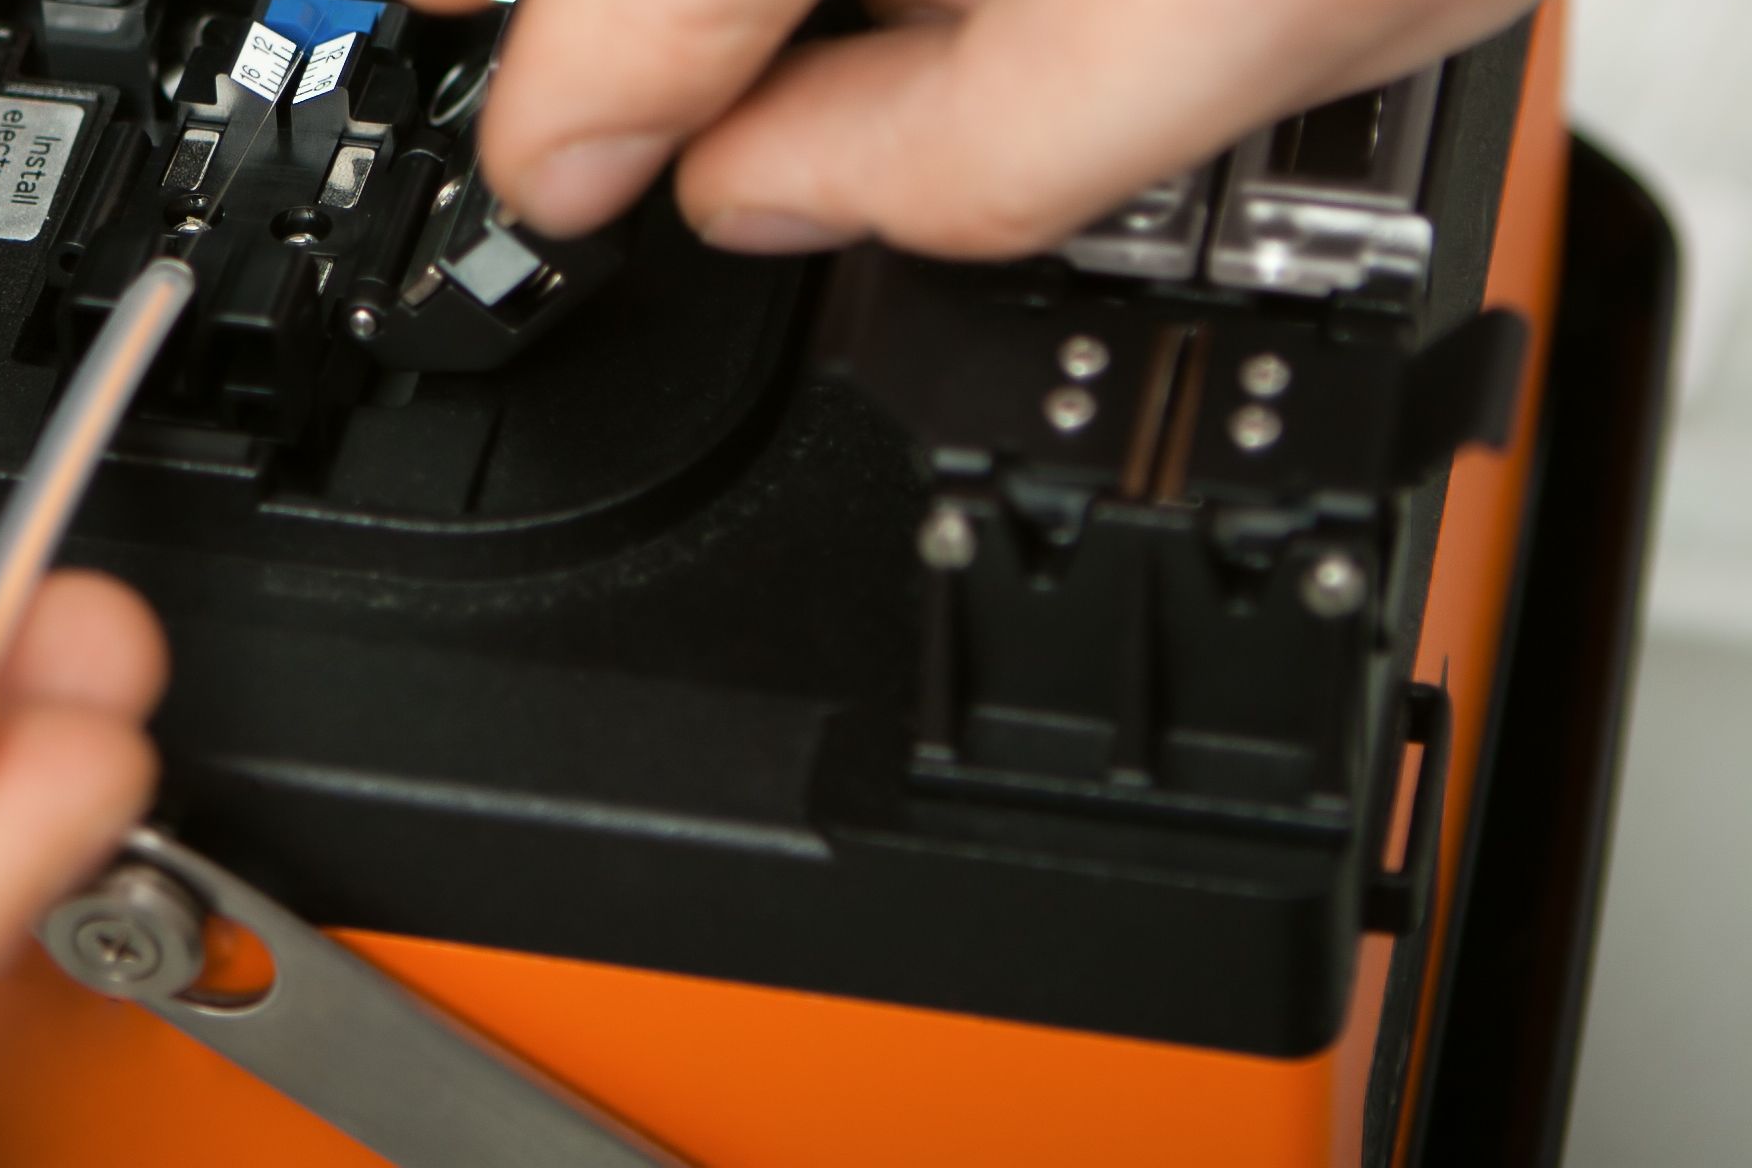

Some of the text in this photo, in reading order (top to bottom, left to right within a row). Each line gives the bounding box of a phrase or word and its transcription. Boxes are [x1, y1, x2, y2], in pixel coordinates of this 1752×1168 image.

[252, 35, 273, 55] 12
[325, 45, 345, 64] 12
[239, 64, 260, 84] 16
[313, 74, 333, 92] 16
[11, 136, 62, 206] Install
